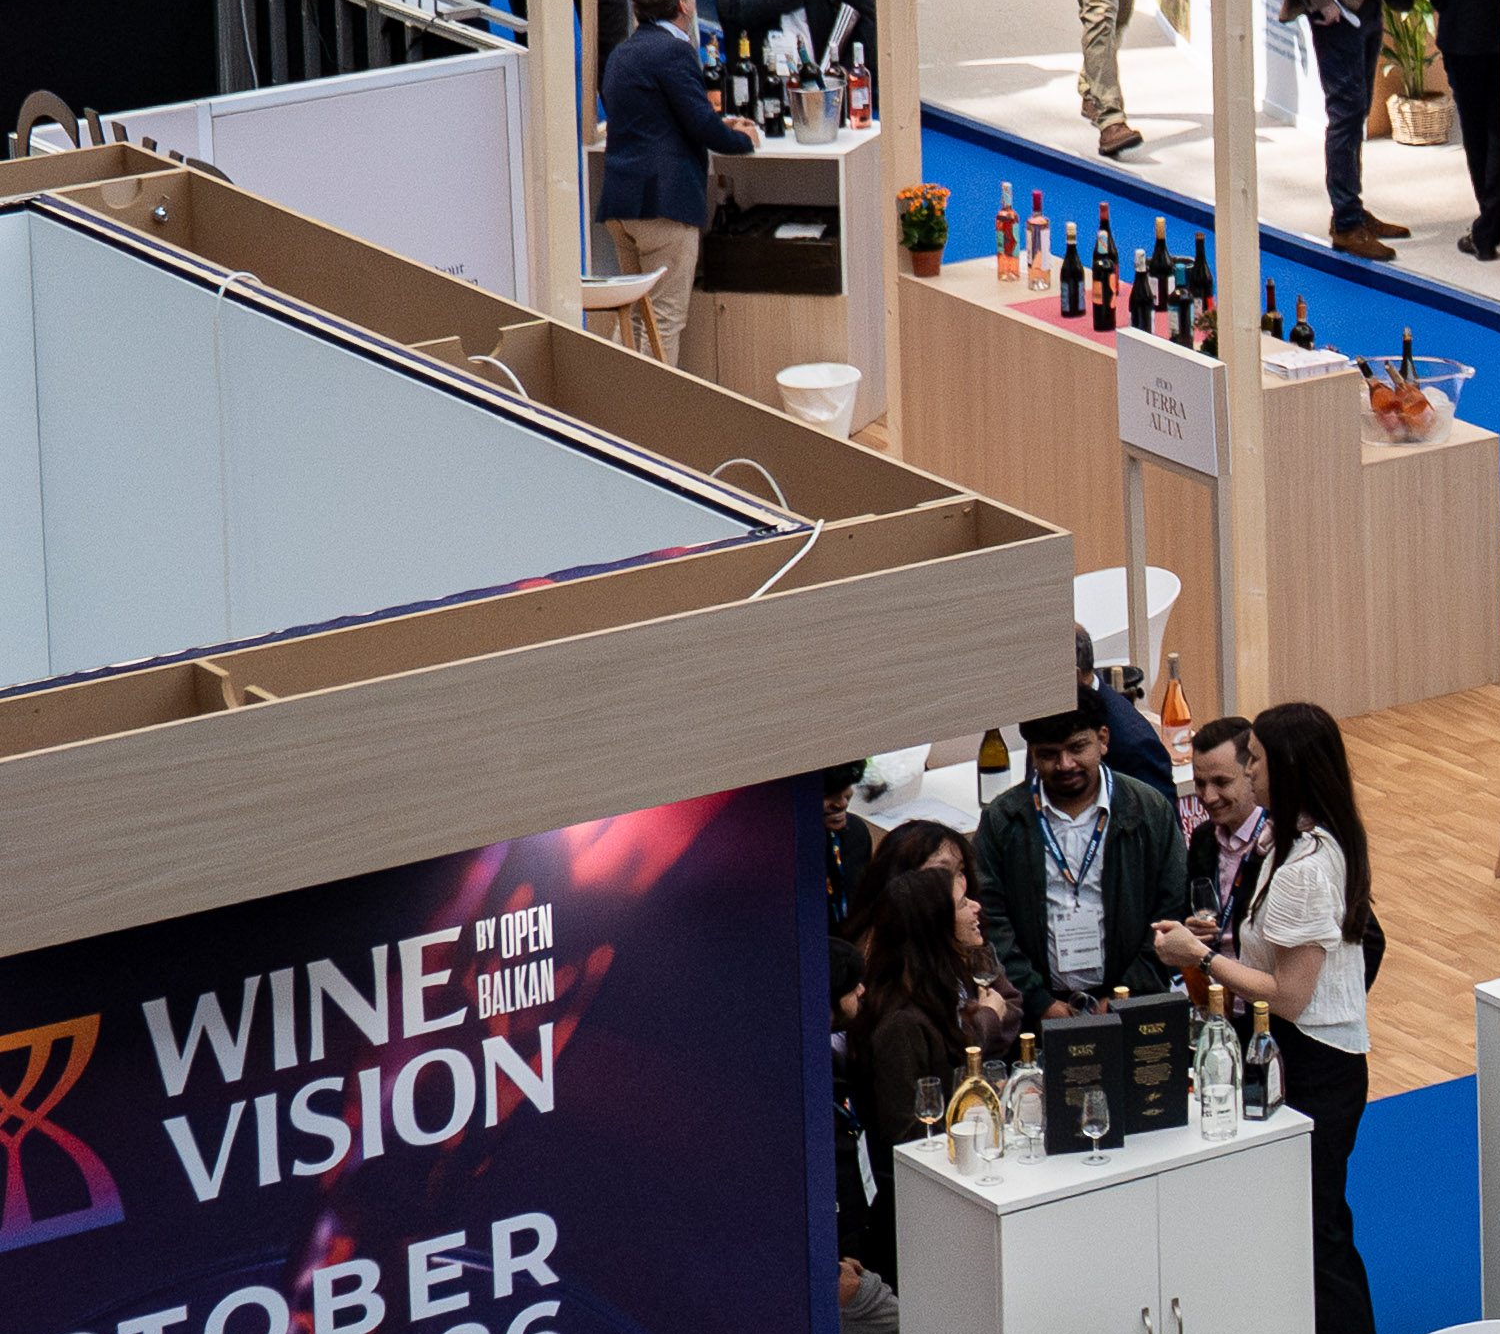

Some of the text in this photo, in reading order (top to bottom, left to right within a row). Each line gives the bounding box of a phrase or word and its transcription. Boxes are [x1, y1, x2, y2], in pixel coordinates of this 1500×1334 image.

[1142, 386, 1187, 420] TERRA
[1150, 412, 1184, 440] ALTA
[141, 903, 554, 1098] WINE BY OPEN
[476, 958, 556, 1020] BALKAN
[162, 1022, 556, 1204] VISION
